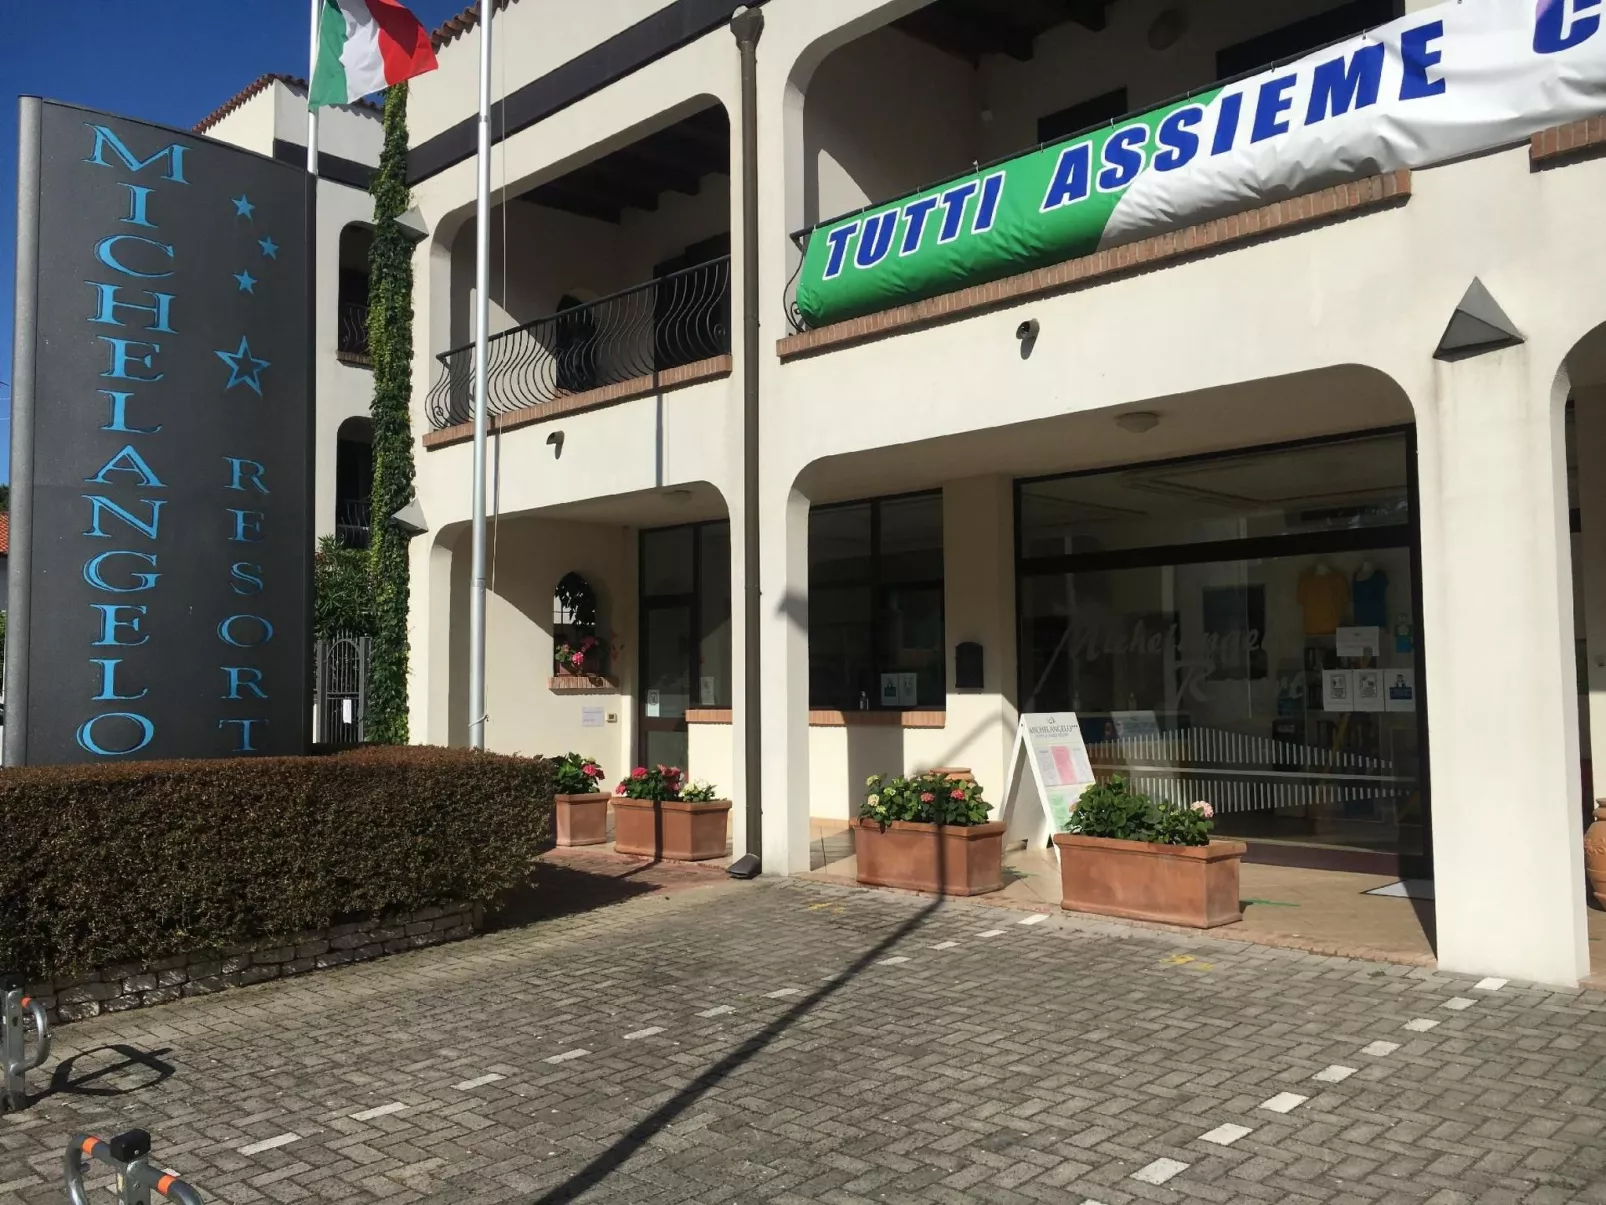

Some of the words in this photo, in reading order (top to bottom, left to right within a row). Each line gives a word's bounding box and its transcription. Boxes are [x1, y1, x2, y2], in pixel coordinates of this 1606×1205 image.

[824, 173, 1003, 278] TUTTI
[1041, 20, 1446, 210] ASSIEME
[75, 122, 191, 757] MICHELANGELO
[216, 456, 273, 752] RESORT
